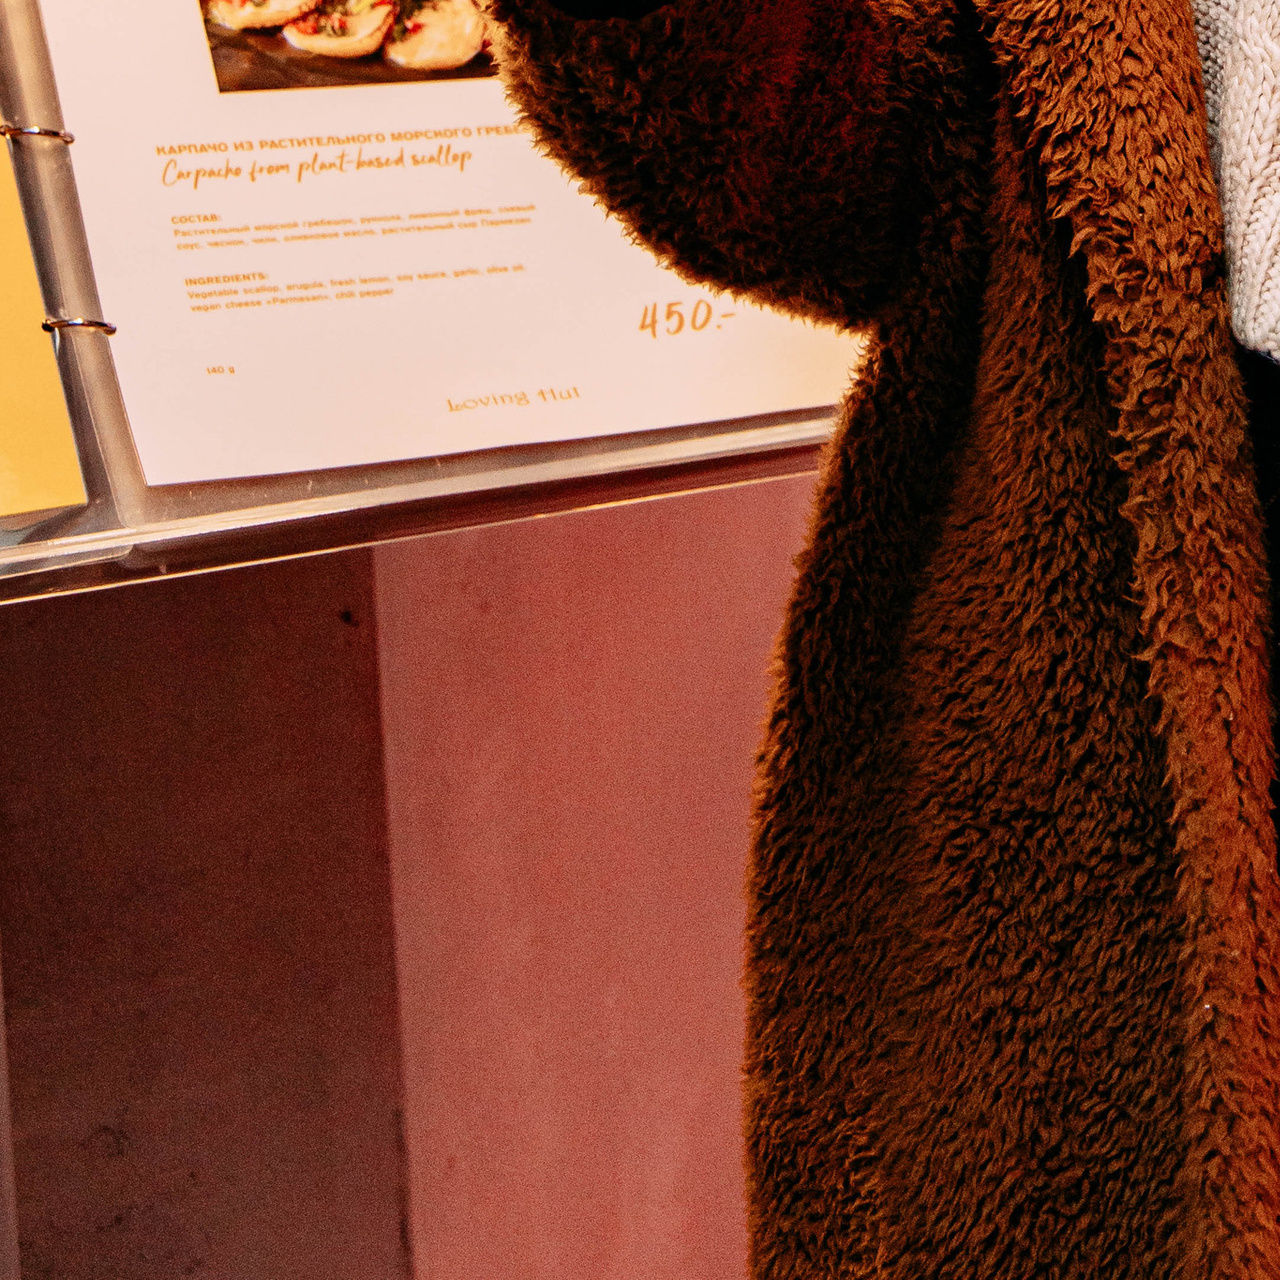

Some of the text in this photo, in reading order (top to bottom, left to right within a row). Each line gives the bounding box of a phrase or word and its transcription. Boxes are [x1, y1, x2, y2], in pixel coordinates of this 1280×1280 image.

[156, 141, 229, 157] КАРПАЧО
[233, 140, 254, 153] ИЗ
[259, 133, 386, 150] РАСТИТЕЛЬНОГО
[390, 126, 473, 143] МОРСКОГО
[161, 143, 473, 191] Carpacho from plant-based scallop
[170, 213, 222, 225] СОСТАВ:
[184, 271, 269, 289] INGREDIENTS:
[447, 390, 531, 413] Loving
